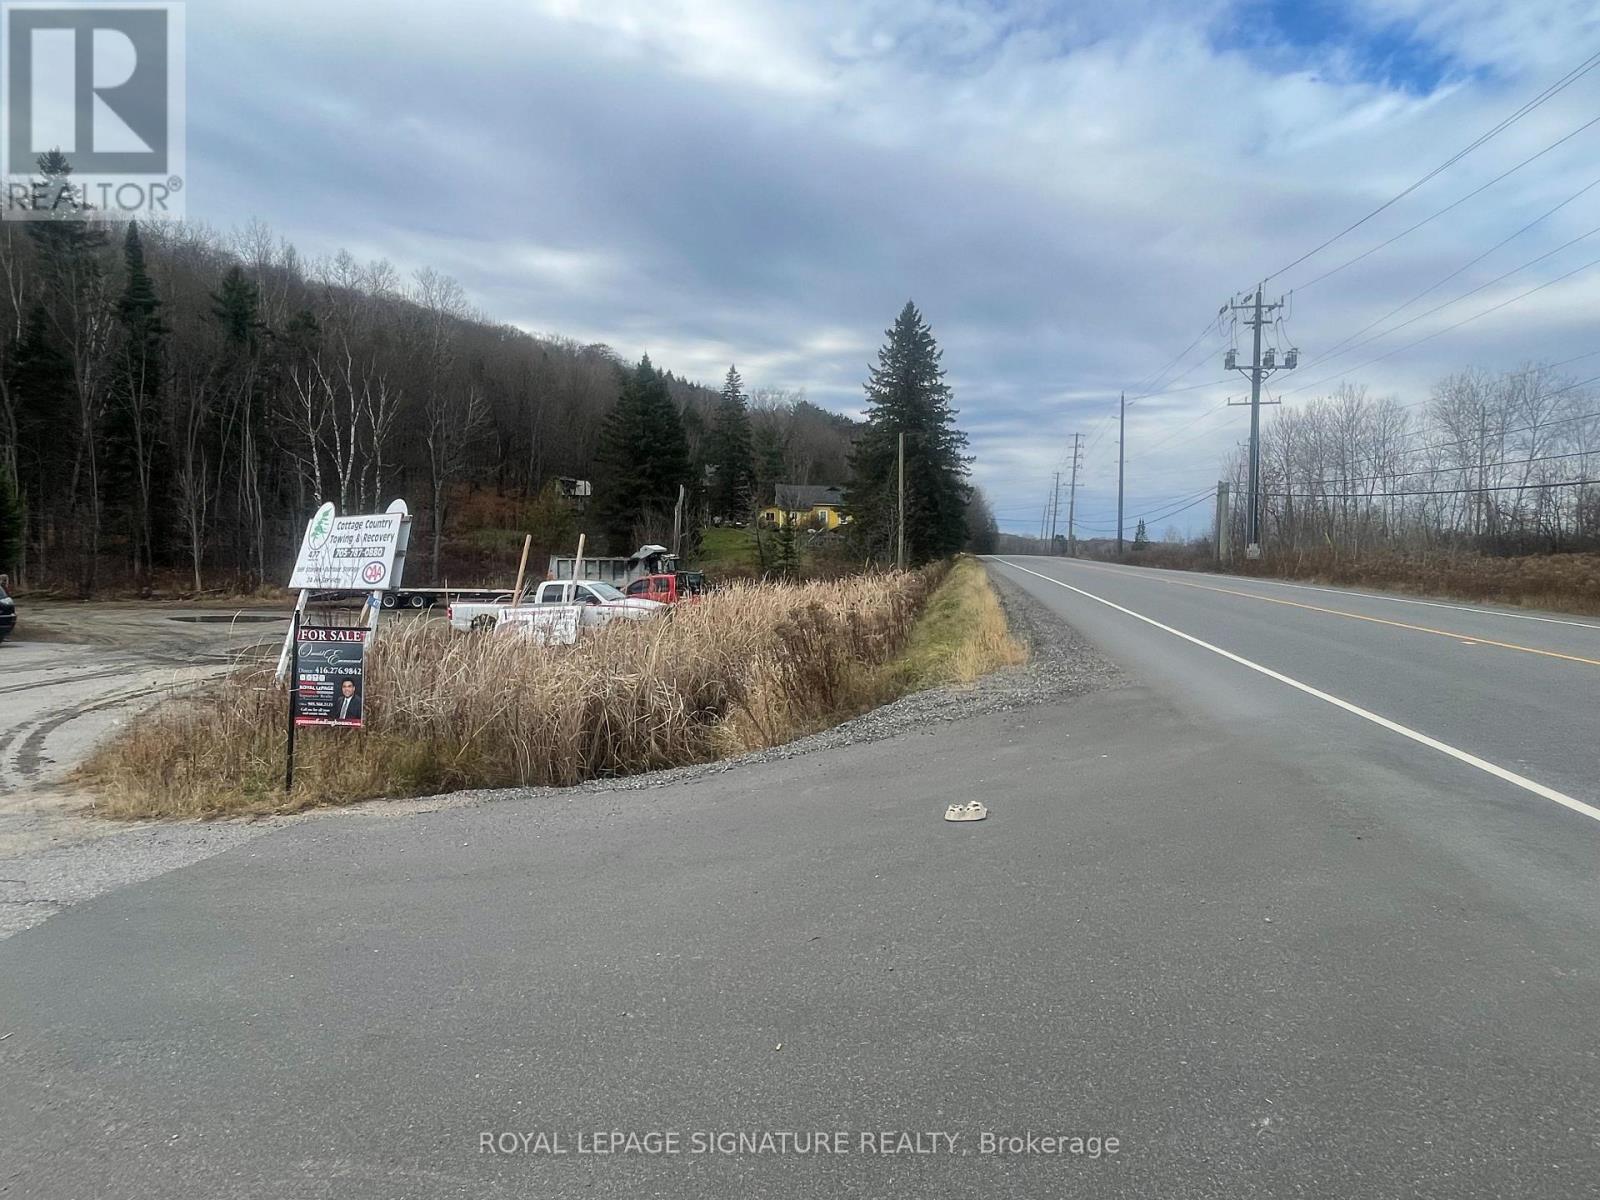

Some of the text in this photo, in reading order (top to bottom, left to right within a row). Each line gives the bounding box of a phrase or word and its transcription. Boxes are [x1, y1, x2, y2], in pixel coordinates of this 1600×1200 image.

[337, 519, 393, 531] Cottage Country
[330, 532, 395, 545] Towing & Recovery
[301, 629, 361, 641] FOR SALE
[315, 667, 362, 675] 416.276.9842
